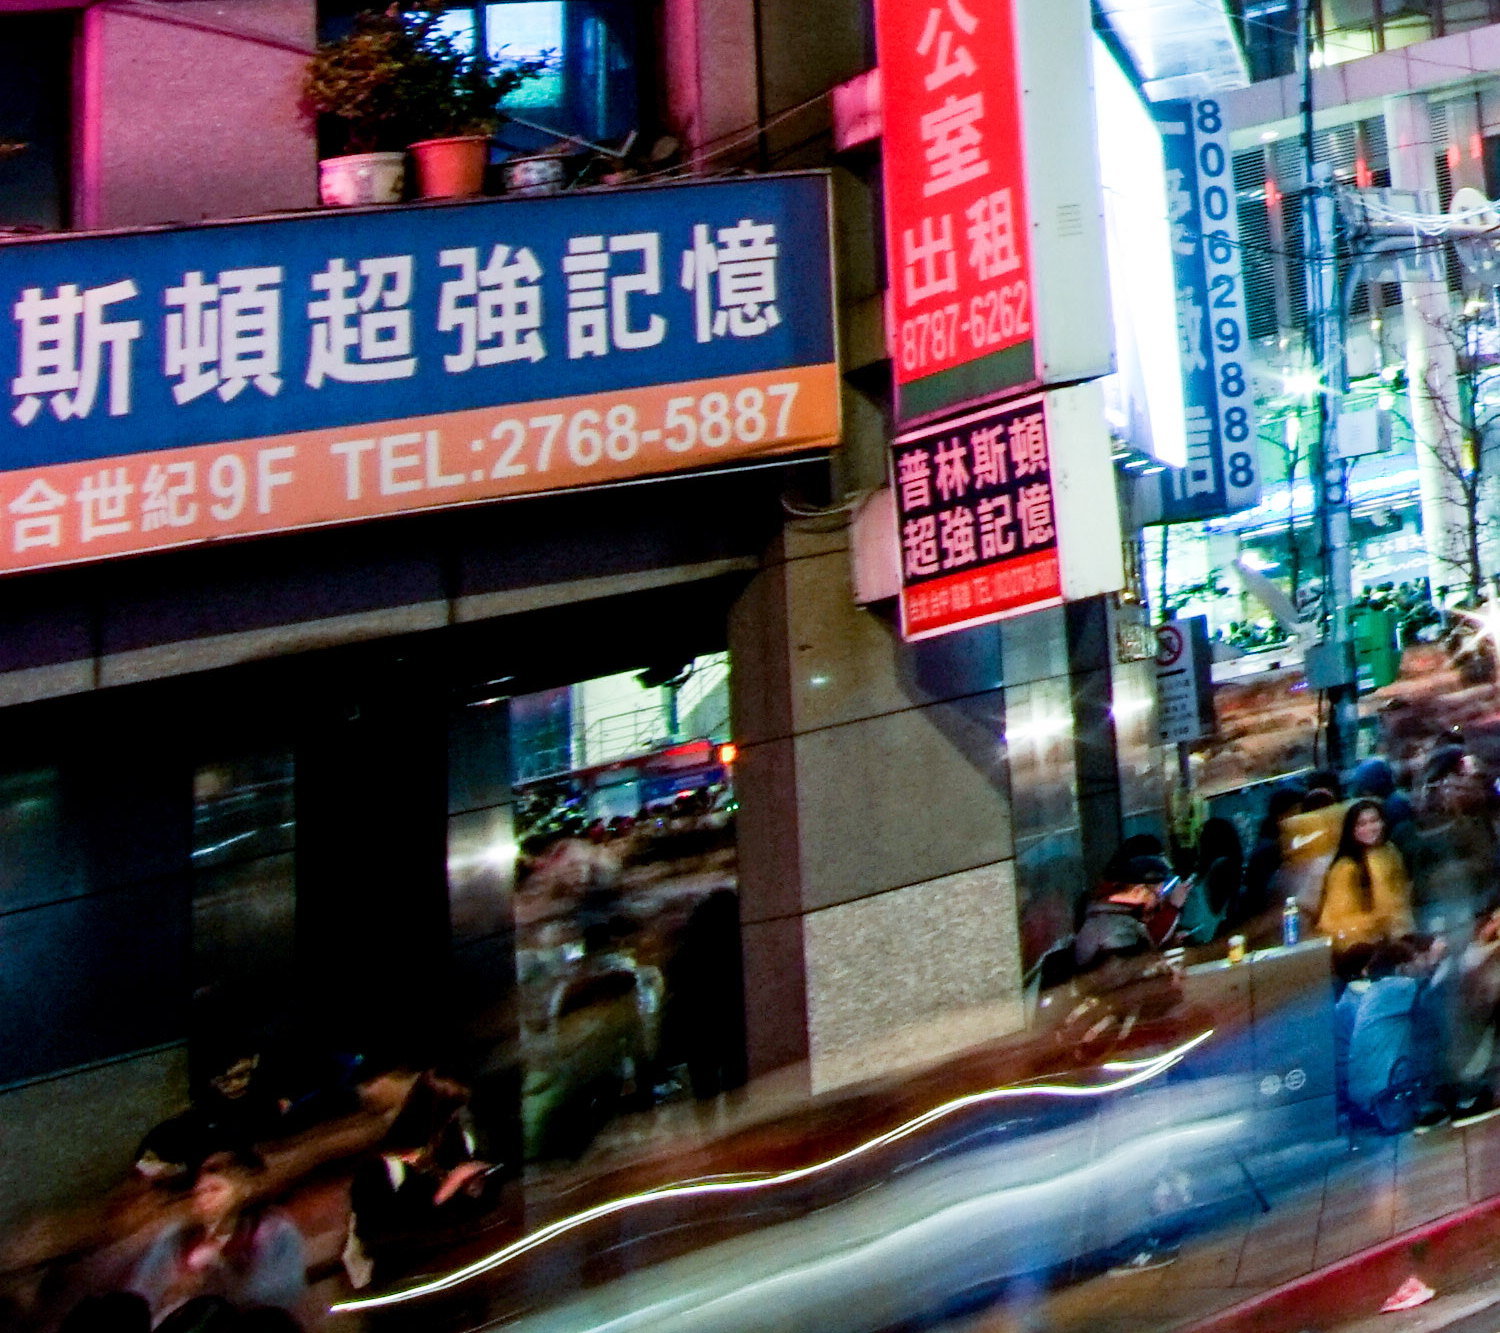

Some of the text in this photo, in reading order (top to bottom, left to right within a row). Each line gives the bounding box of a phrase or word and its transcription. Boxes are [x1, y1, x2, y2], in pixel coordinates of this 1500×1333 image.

[903, 187, 1021, 308] 出租
[10, 219, 782, 427] 斯頓超強記憶
[902, 280, 1031, 371] 8787-6262
[898, 412, 1048, 513] 普林斯頓
[903, 482, 1056, 577] 超強記憶
